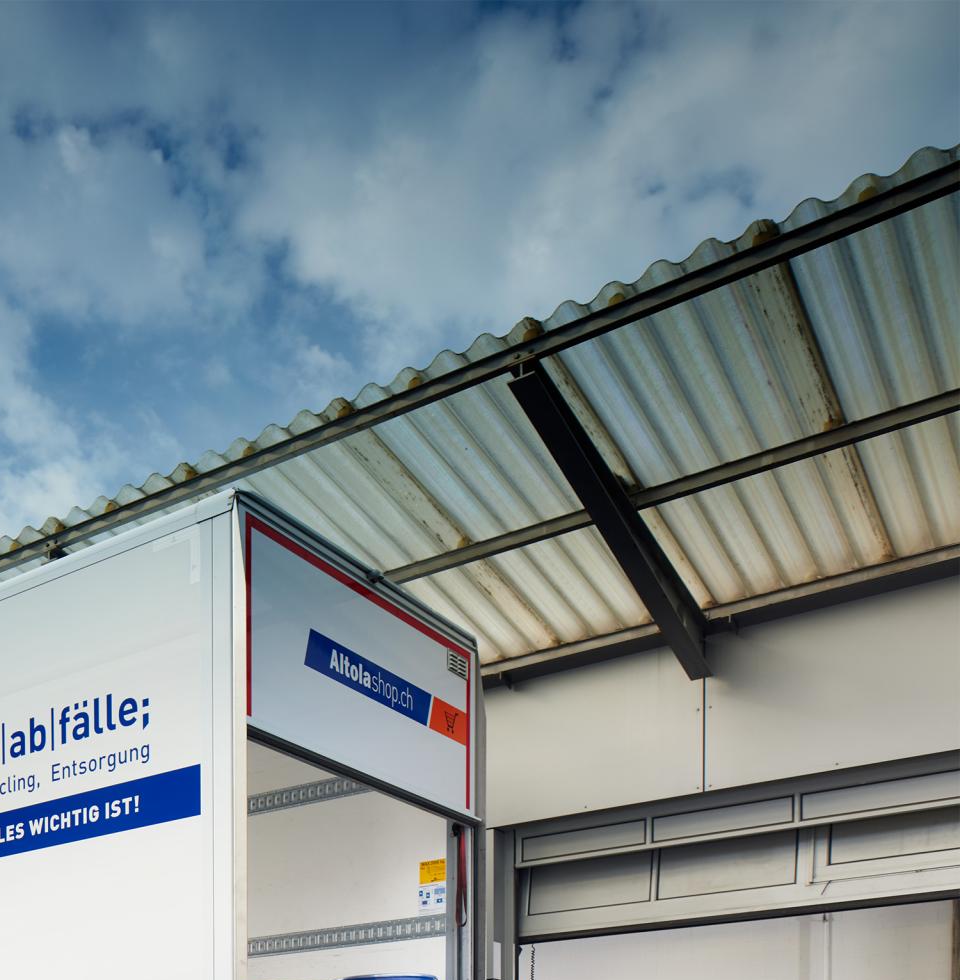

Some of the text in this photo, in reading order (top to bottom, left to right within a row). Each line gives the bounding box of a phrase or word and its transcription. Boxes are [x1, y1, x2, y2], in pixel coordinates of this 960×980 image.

[330, 649, 414, 712] Altolashop.ch
[51, 744, 150, 782] Entsorgung
[28, 805, 100, 836] WICHTIG
[105, 795, 140, 819] IST!
